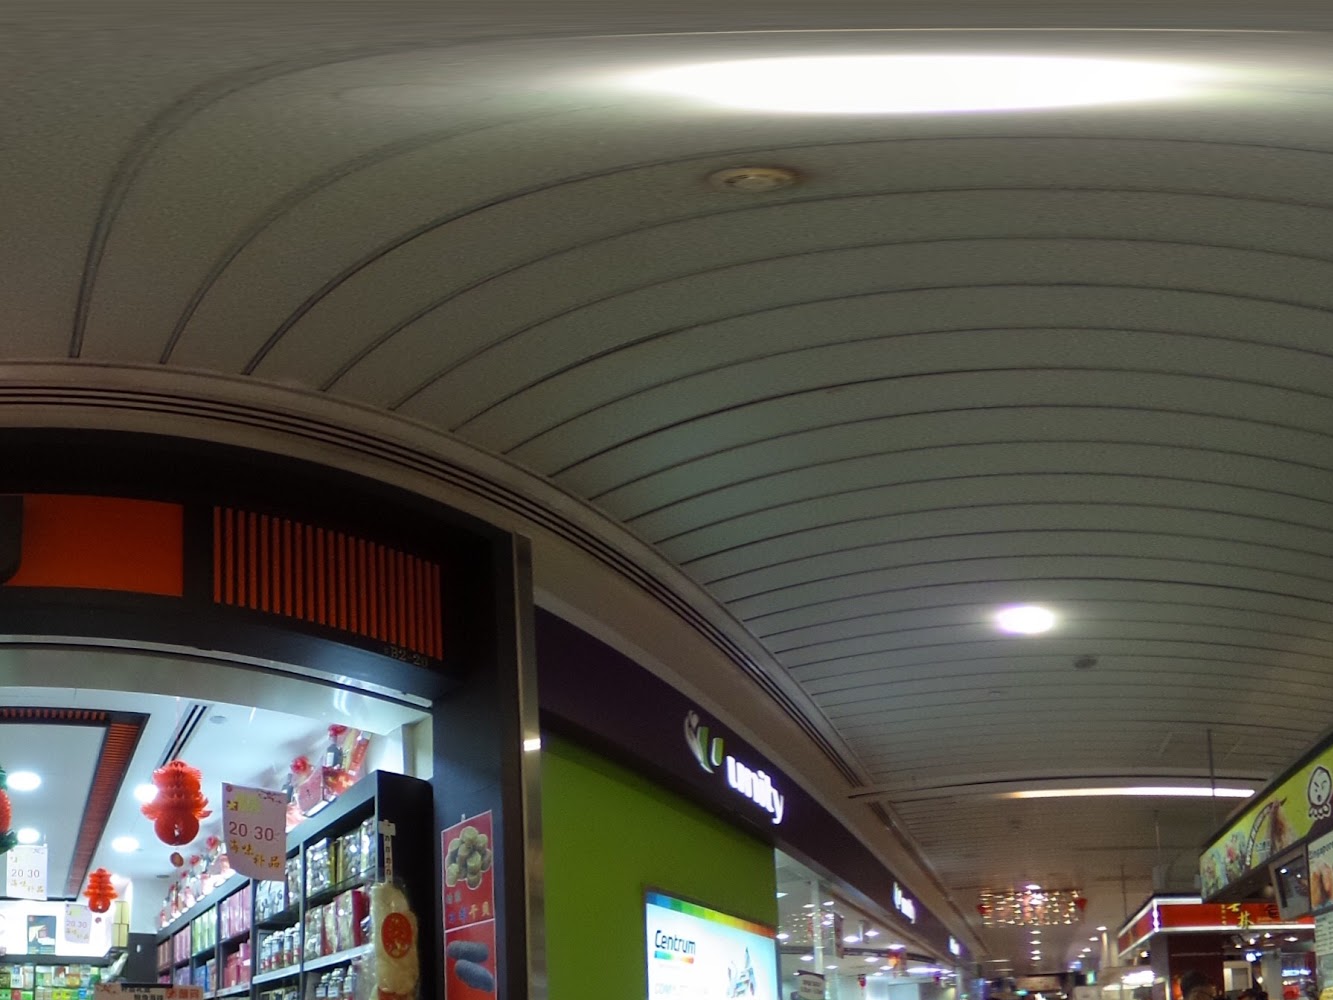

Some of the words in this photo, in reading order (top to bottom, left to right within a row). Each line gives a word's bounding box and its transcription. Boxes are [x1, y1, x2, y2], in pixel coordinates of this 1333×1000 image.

[726, 755, 784, 825] unity
[229, 821, 248, 837] 20
[254, 826, 274, 841] 30
[11, 869, 24, 878] 20
[27, 869, 40, 879] 30
[655, 930, 696, 955] Centrum
